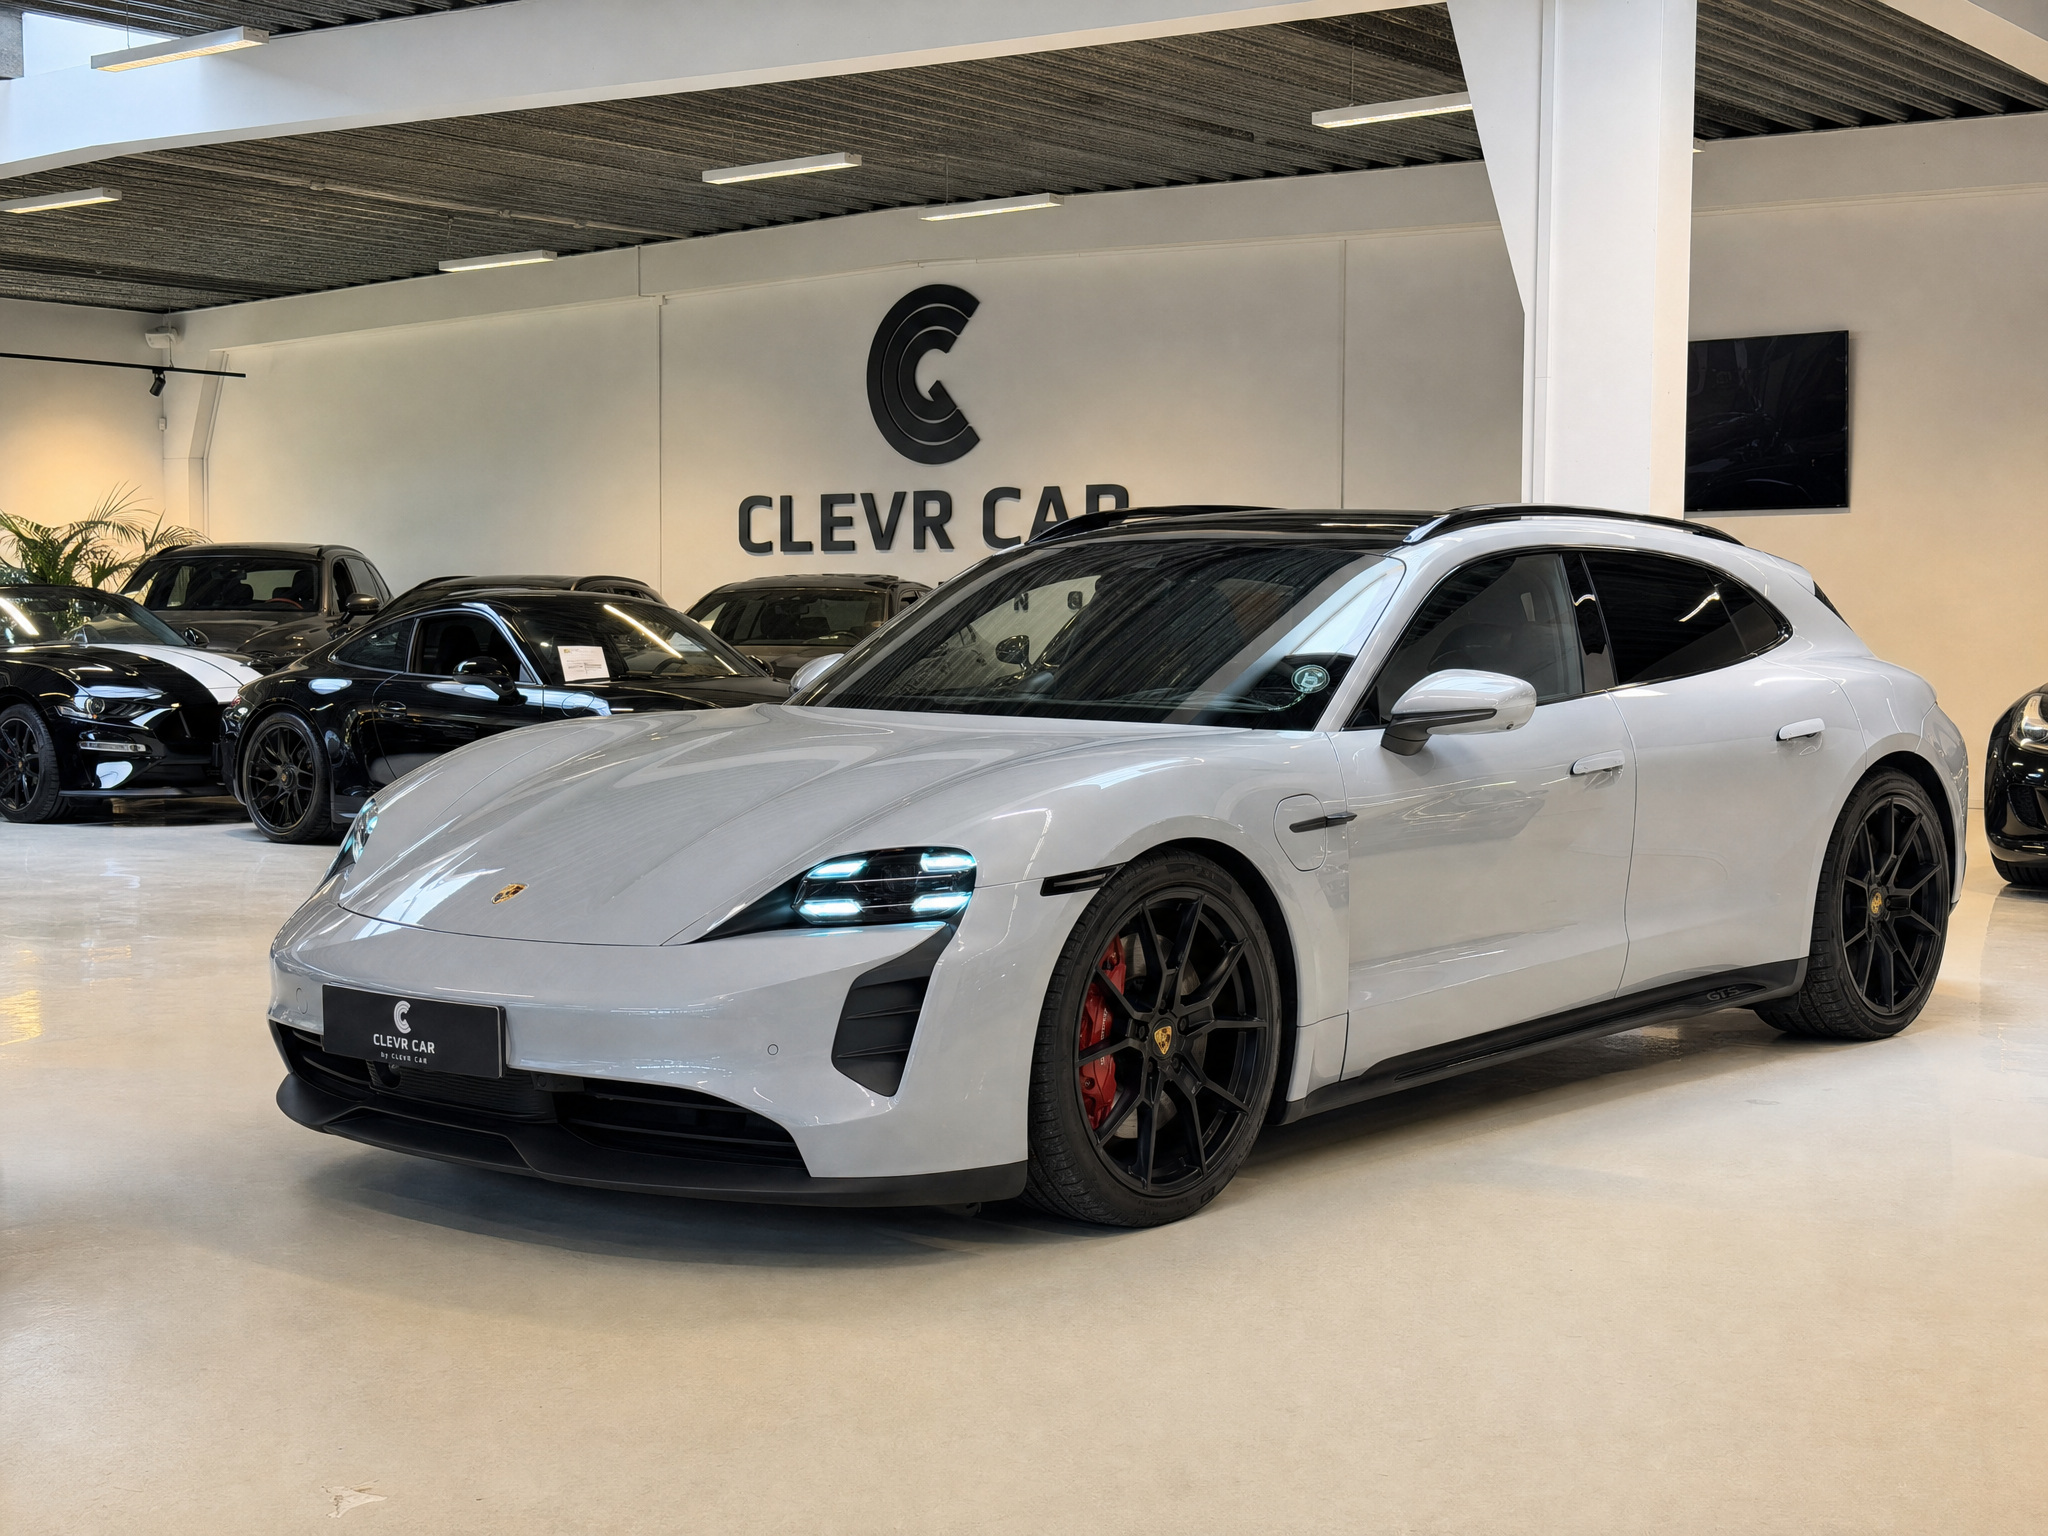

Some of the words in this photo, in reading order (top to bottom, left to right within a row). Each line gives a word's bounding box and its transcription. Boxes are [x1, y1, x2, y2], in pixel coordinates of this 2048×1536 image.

[738, 490, 954, 553] CLEVR
[1706, 985, 1740, 1001] GTS
[373, 1033, 409, 1050] CLEVR
[411, 1039, 435, 1054] CAR
[391, 1053, 411, 1062] CLEVR
[414, 1056, 428, 1064] CAR
